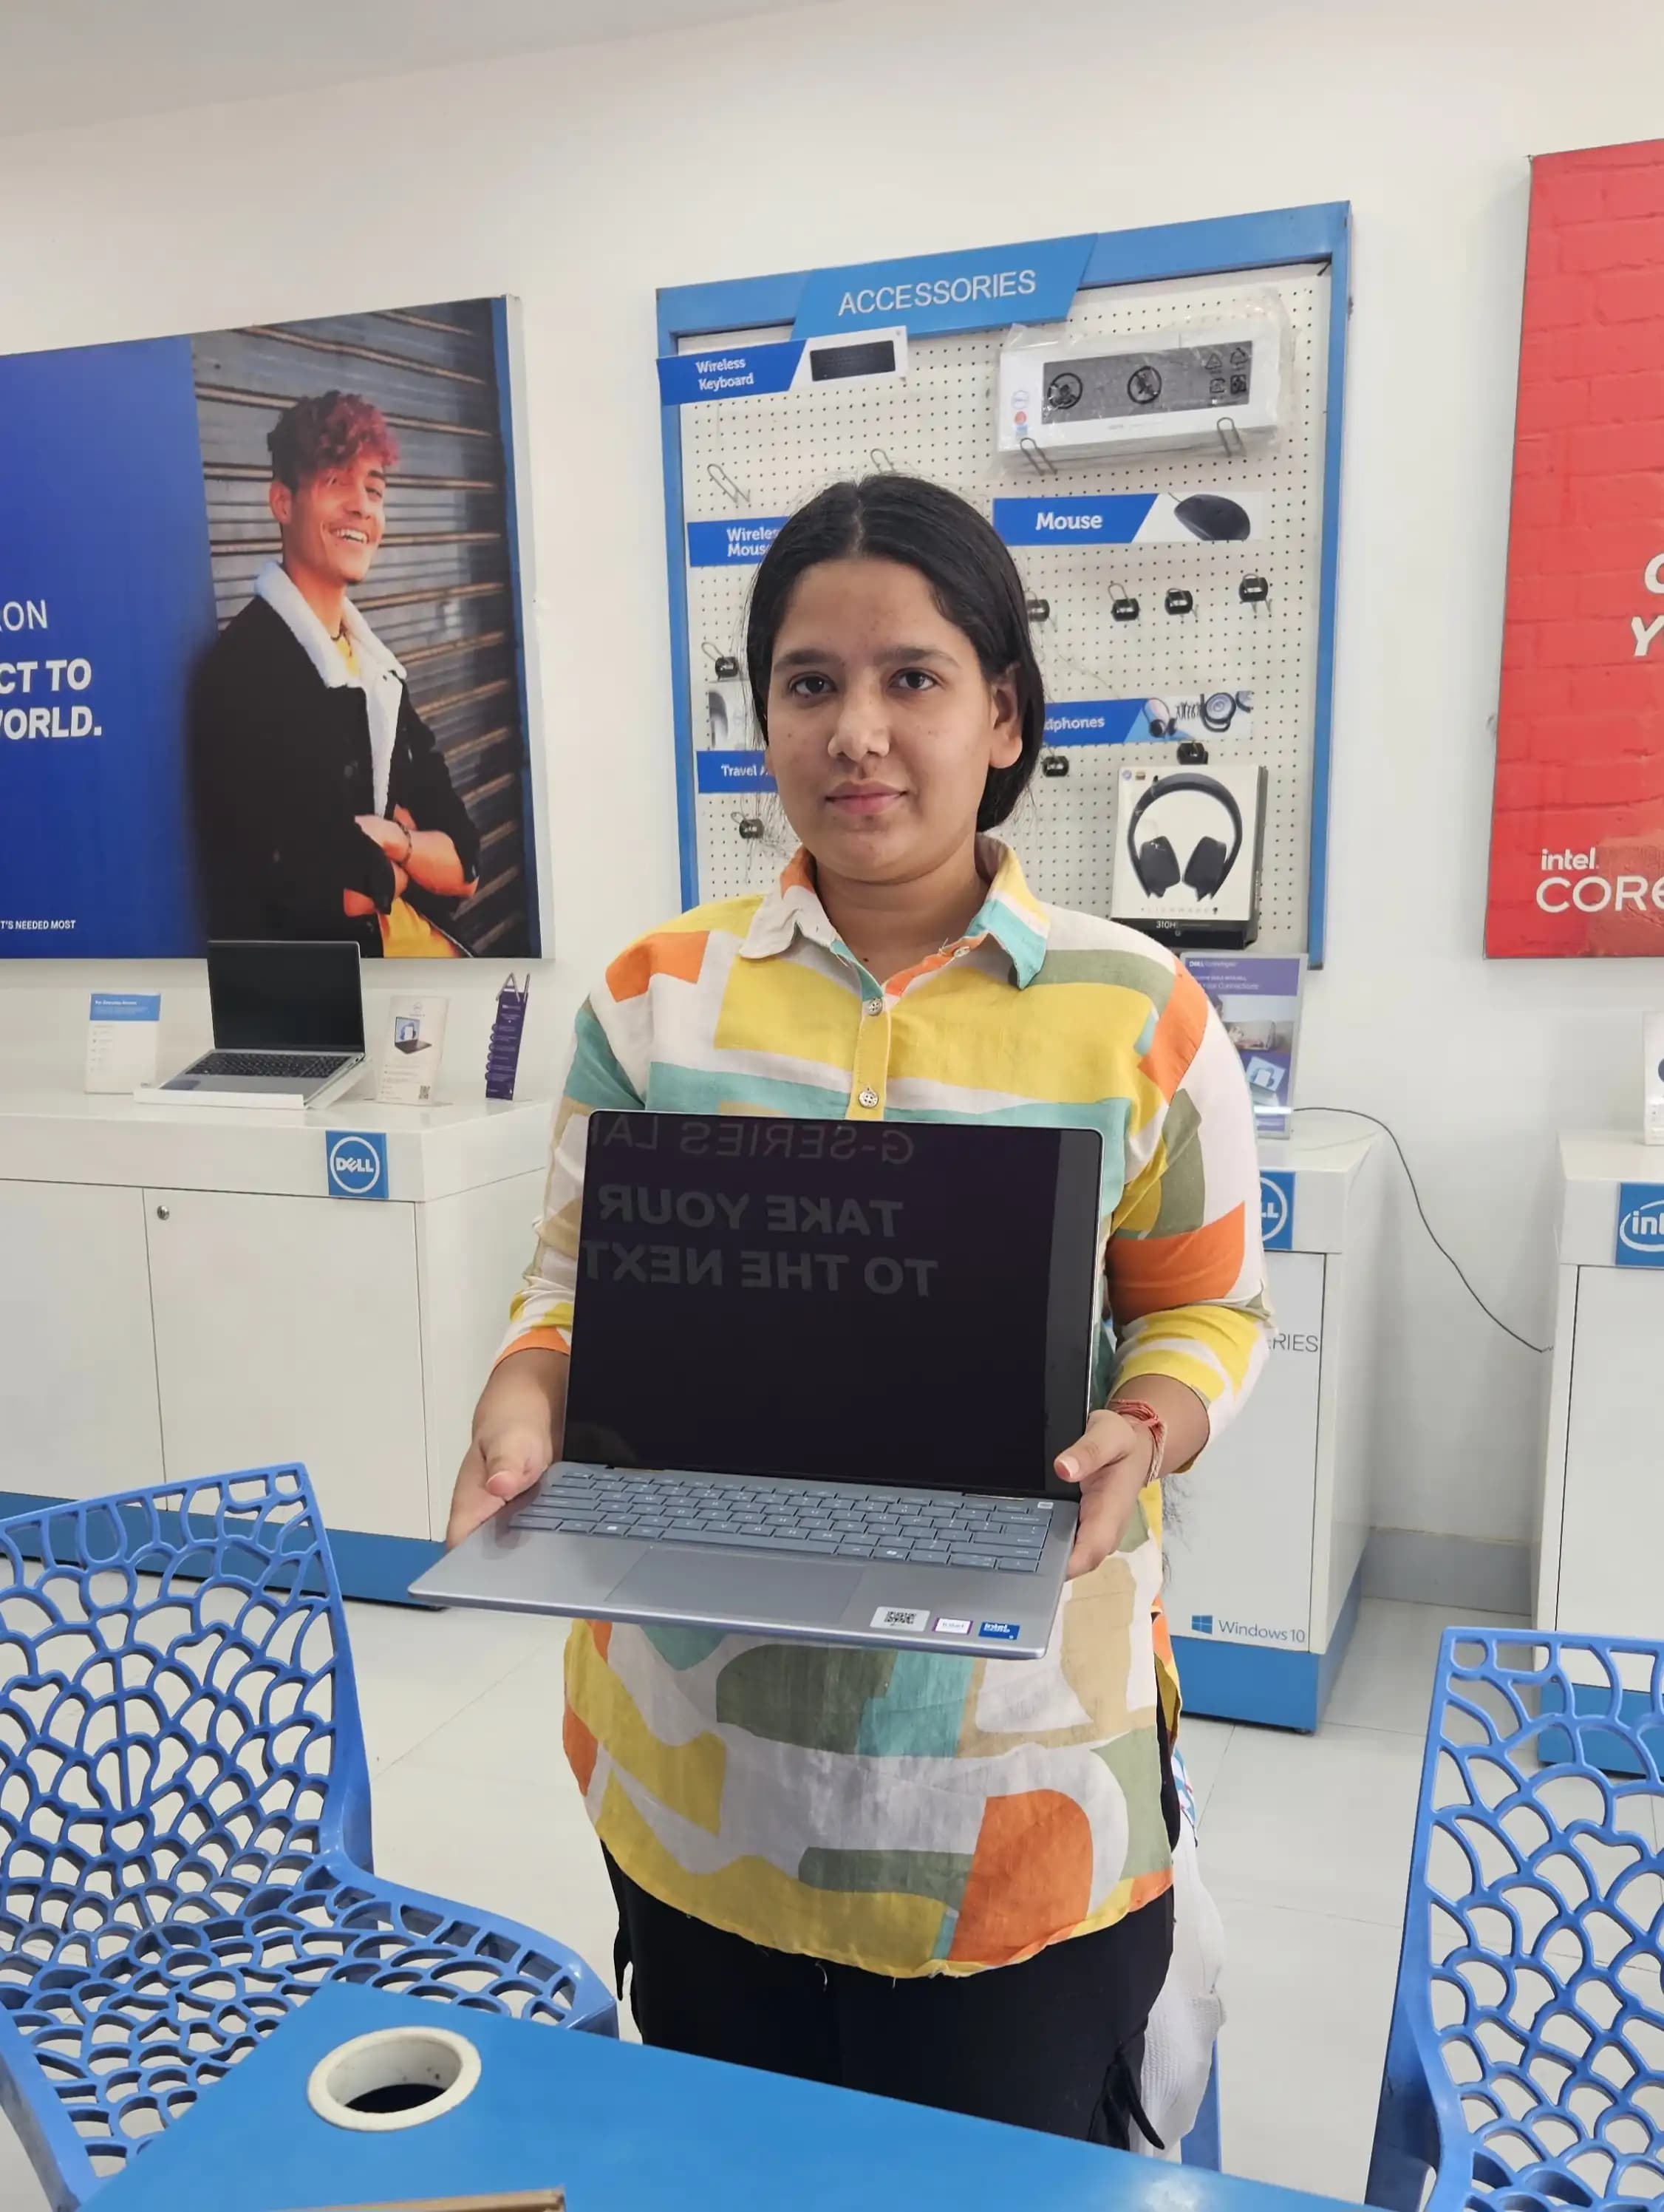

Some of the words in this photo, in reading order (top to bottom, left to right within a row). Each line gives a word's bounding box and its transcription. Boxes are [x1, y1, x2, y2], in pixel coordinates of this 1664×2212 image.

[838, 269, 1036, 317] ACCESSORIES
[695, 358, 746, 374] Wireless
[698, 372, 754, 392] Keyboard
[1035, 511, 1103, 531] Mouse
[726, 526, 782, 542] Wireles
[0, 599, 48, 633] ON
[46, 658, 92, 691] TO
[0, 705, 102, 740] ORLD.
[720, 763, 757, 777] Travel
[15, 920, 50, 930] NEEDED
[50, 919, 76, 930] MOST
[335, 1157, 375, 1173] DELL
[1269, 1333, 1319, 1352] RIES
[1218, 1619, 1288, 1641] Windows
[1290, 1629, 1306, 1643] 10
